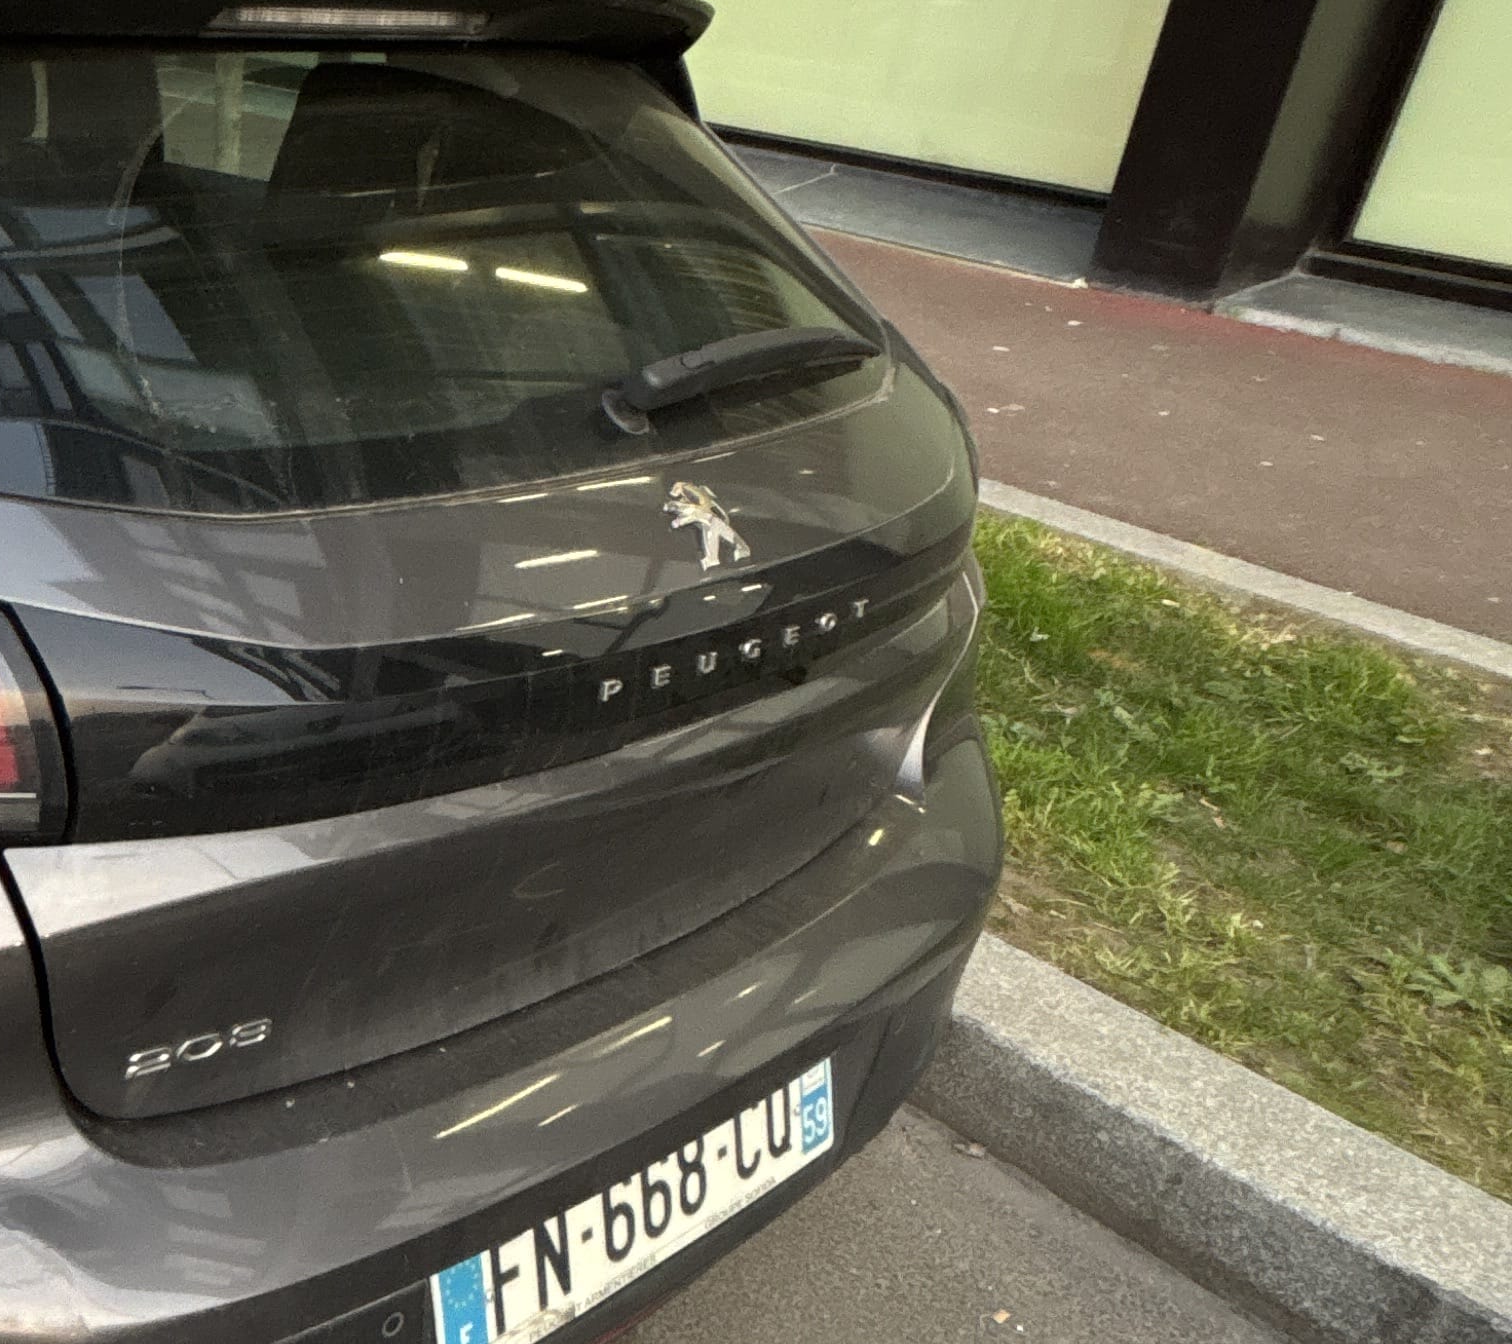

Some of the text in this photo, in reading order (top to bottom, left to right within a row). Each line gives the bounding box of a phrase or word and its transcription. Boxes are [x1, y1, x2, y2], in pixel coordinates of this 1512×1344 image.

[599, 598, 870, 702] PEUGEOT
[125, 1018, 272, 1080] 208
[803, 1097, 828, 1143] 59
